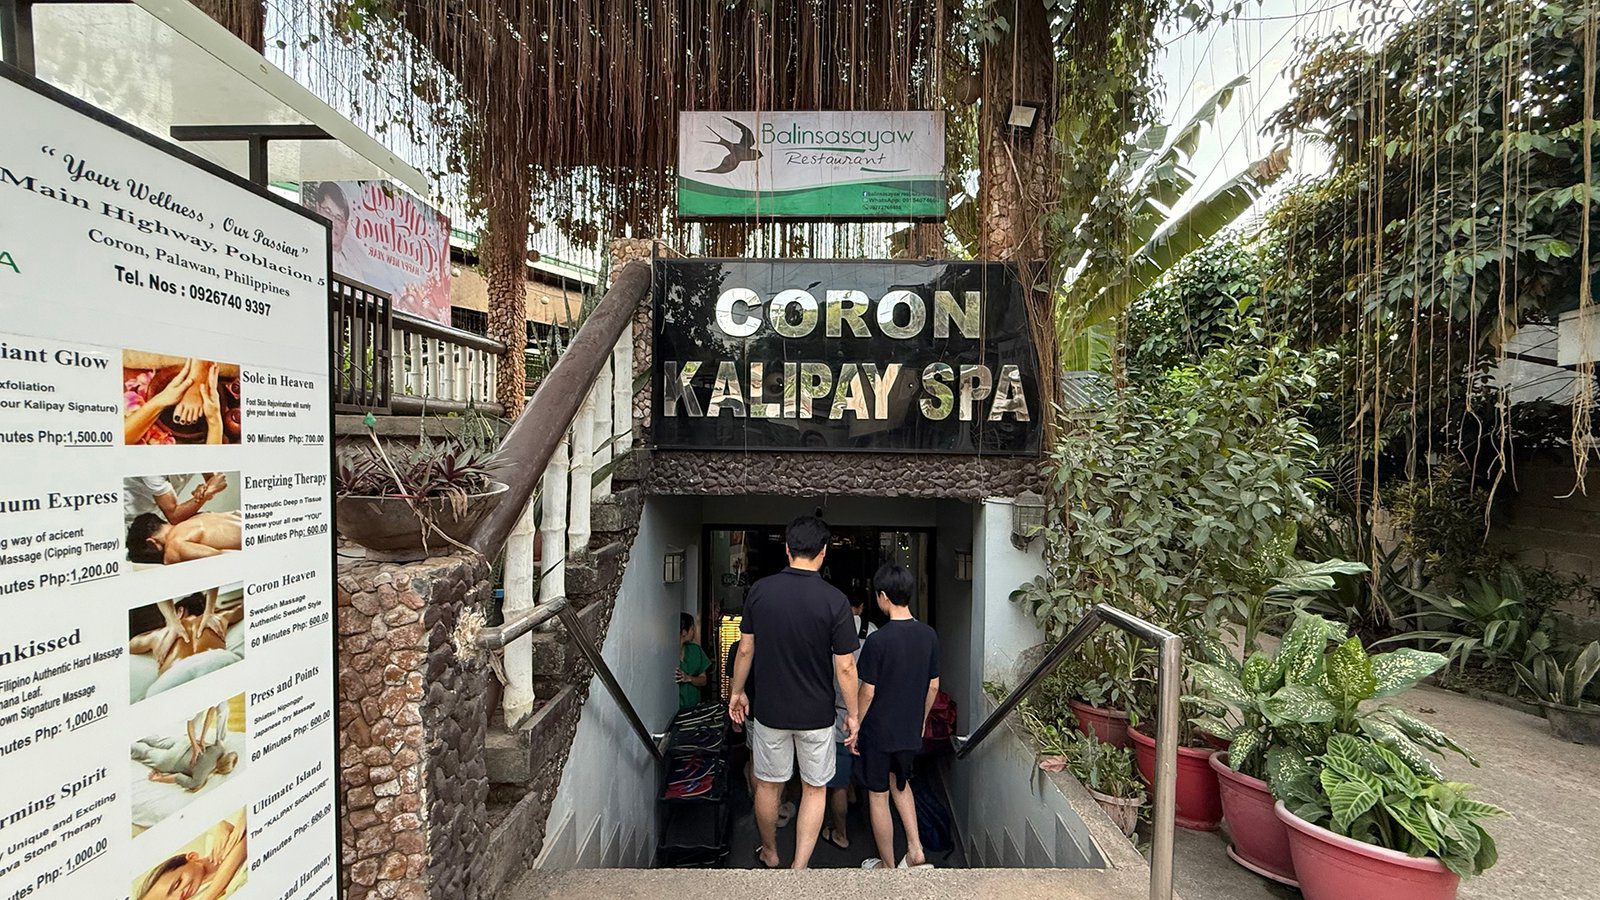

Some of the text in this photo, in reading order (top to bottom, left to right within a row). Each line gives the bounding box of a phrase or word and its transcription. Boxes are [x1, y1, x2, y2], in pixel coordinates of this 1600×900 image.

[762, 123, 914, 151] Balinsasayaw
[785, 151, 887, 165] Restaurant
[63, 154, 122, 191] Your
[126, 178, 204, 222] Wellness
[222, 217, 250, 239] Our
[0, 167, 325, 287] Main Highway, Poblacion 5
[87, 228, 290, 298] Coron, Palawan, Philippines
[114, 264, 144, 287] Tel.
[189, 284, 242, 310] 0926740
[244, 298, 271, 317] 9397
[715, 288, 981, 340] CORON
[54, 349, 109, 370] Glow
[242, 370, 314, 389] Sole in Heaven
[663, 360, 1030, 422] KALIPAY SPA
[24, 399, 65, 412] Kalipay
[68, 402, 118, 414] Signature)
[246, 397, 257, 406] Foot
[257, 398, 267, 407] Skin
[292, 402, 300, 410] will
[300, 402, 311, 411] surely
[246, 408, 256, 417] give
[256, 409, 266, 417] your
[246, 434, 324, 445] 90 Minutes Php: 700.00
[245, 473, 327, 491] Energizing Therapy
[47, 492, 118, 511] Express
[245, 500, 282, 511] Therapeutic
[283, 499, 298, 507] Deep
[245, 511, 273, 520] Massage
[245, 537, 255, 547] 60
[257, 532, 287, 545] Minutes
[307, 523, 328, 535] 600.00
[268, 519, 282, 528] your
[0, 538, 120, 566] Massage (Cipping Therapy)
[11, 535, 32, 548] way
[36, 532, 46, 543] of
[247, 570, 316, 596] Coron Heaven
[249, 594, 306, 617] Swedish Massage
[249, 600, 322, 630] Authentic Sweden Style
[251, 638, 261, 648] 60
[262, 628, 291, 644] Minutes
[309, 612, 329, 627] 600.00
[32, 662, 72, 684] Authentic
[72, 655, 92, 670] Hard
[92, 646, 124, 663] Massage
[21, 686, 43, 703] Leaf.
[250, 666, 320, 707] Press and Points
[20, 696, 61, 719] Signature
[62, 685, 96, 704] Massage
[35, 724, 62, 743] Php:
[65, 703, 109, 730] 1,000.00
[253, 702, 316, 739] Japanese Dry Massage
[254, 710, 277, 725] Shiatsu
[251, 750, 262, 762] 60
[263, 735, 292, 756] Minutes
[310, 709, 331, 727] 600.00
[60, 767, 108, 799] Spirit
[253, 761, 322, 815] Ultimate Island
[7, 793, 117, 855] Unique and Exciting
[23, 839, 58, 863] Stone
[60, 814, 103, 842] Therapy
[250, 827, 263, 839] The
[36, 866, 63, 890] Php:
[65, 837, 108, 871] 1,000.00
[251, 859, 262, 872] 60
[262, 835, 293, 863] Minutes
[300, 853, 332, 887] Harmony
